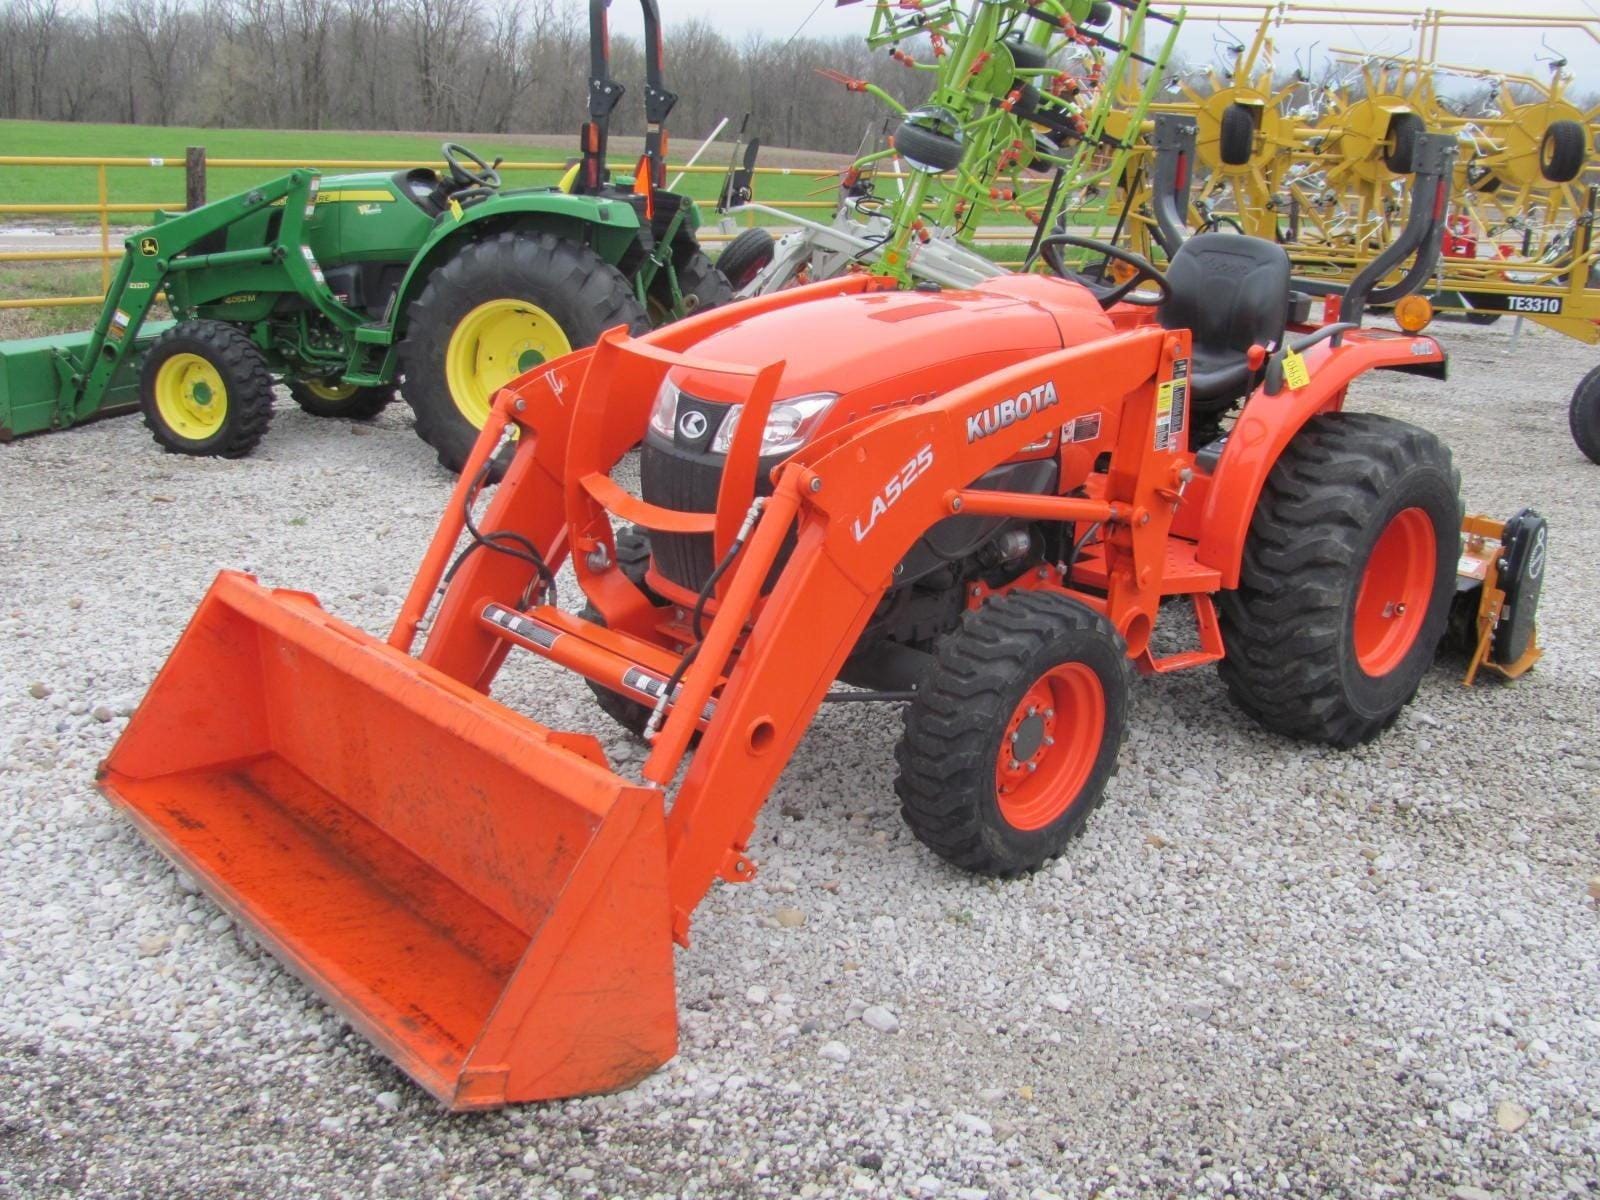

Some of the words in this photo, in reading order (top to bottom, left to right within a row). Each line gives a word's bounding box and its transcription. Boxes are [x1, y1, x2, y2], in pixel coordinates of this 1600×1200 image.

[1507, 296, 1559, 312] TE3310
[966, 381, 1059, 444] KUBOTA
[853, 443, 934, 542] LA525
